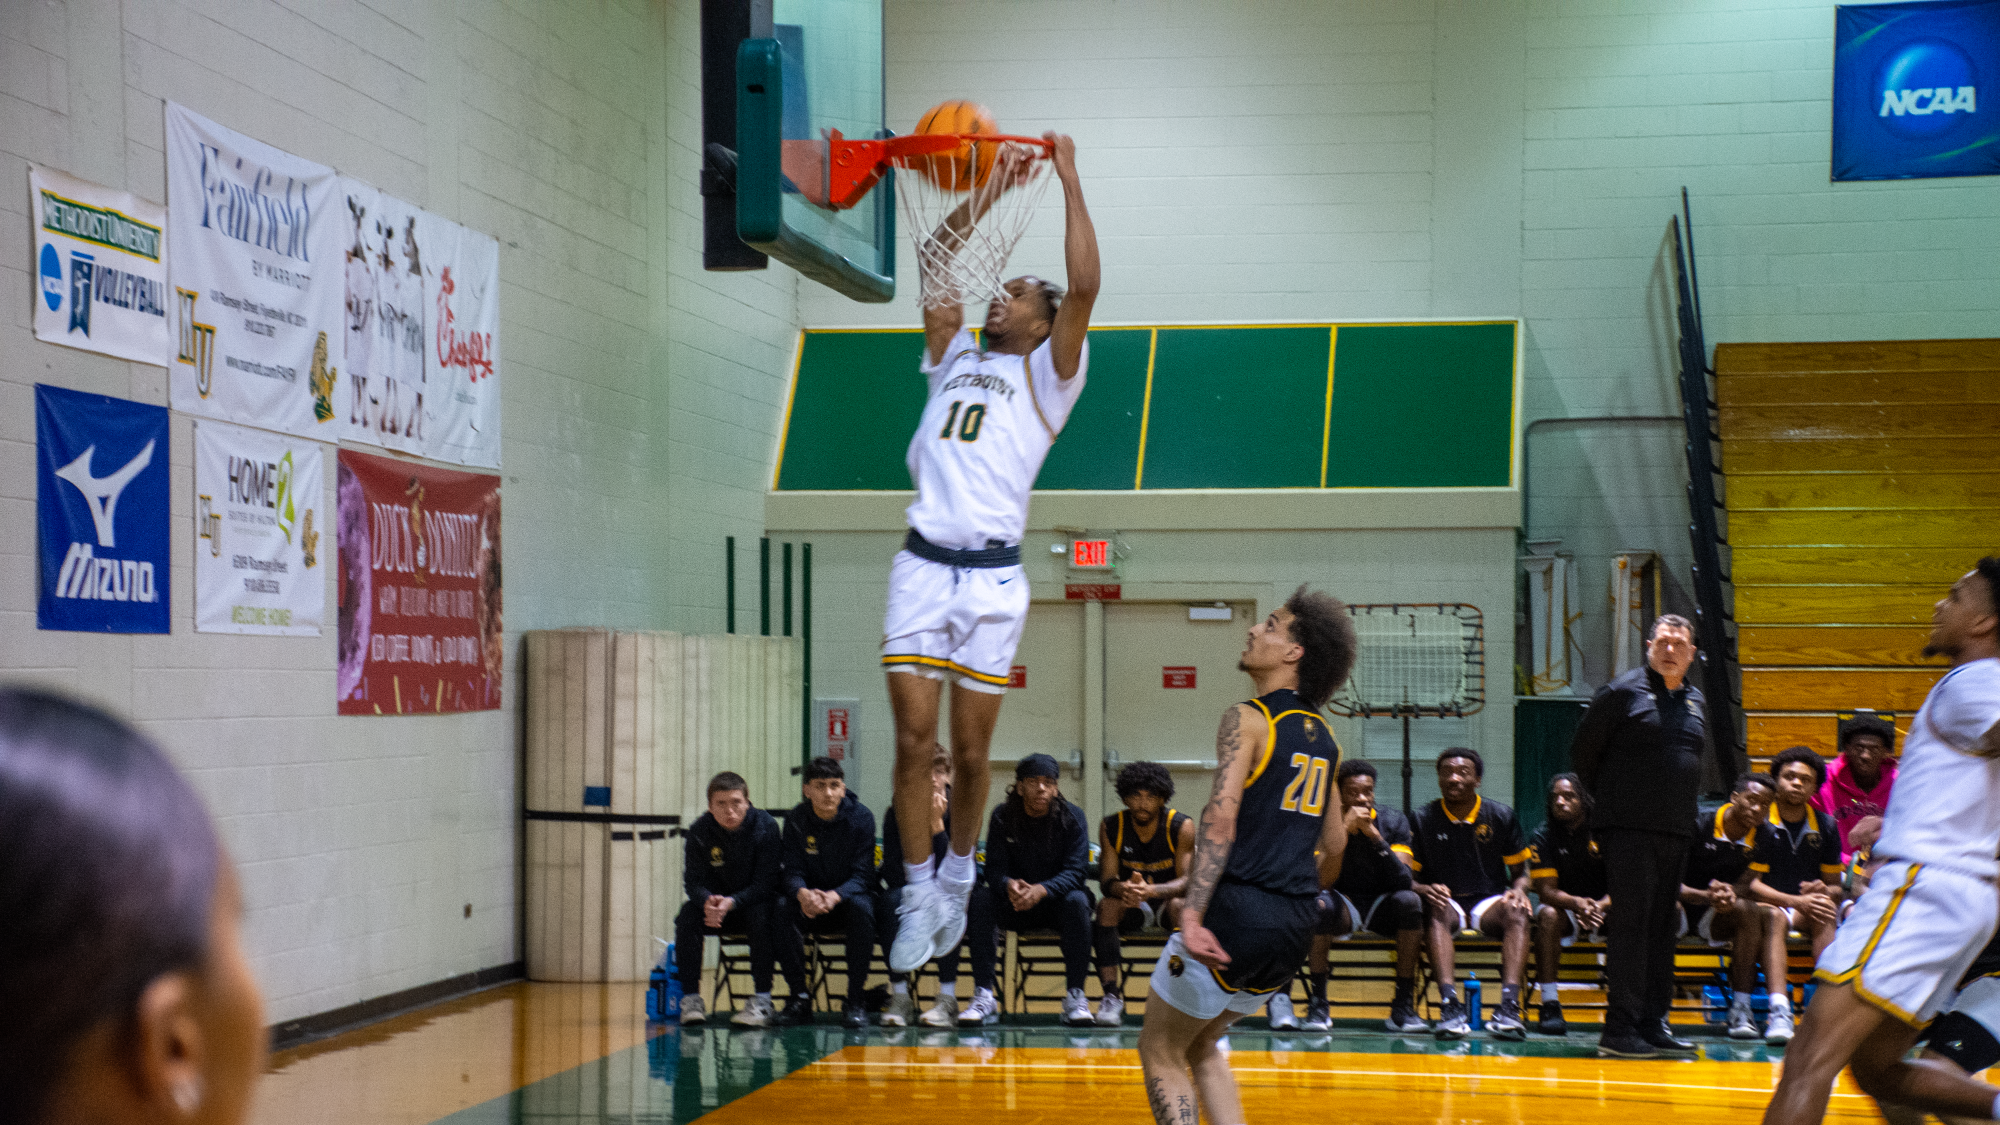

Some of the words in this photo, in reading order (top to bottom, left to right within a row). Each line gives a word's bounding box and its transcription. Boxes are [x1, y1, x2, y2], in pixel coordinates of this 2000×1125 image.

[1879, 86, 1976, 117] NCAA
[43, 194, 108, 241] METHODIST
[199, 142, 310, 262] Fairfield
[95, 264, 165, 317] VOLLEYBALL
[939, 400, 988, 444] 10
[372, 502, 415, 573] DUCK
[424, 509, 478, 579] DONUTS
[1074, 540, 1109, 566] EXIT
[1279, 752, 1330, 817] 20
